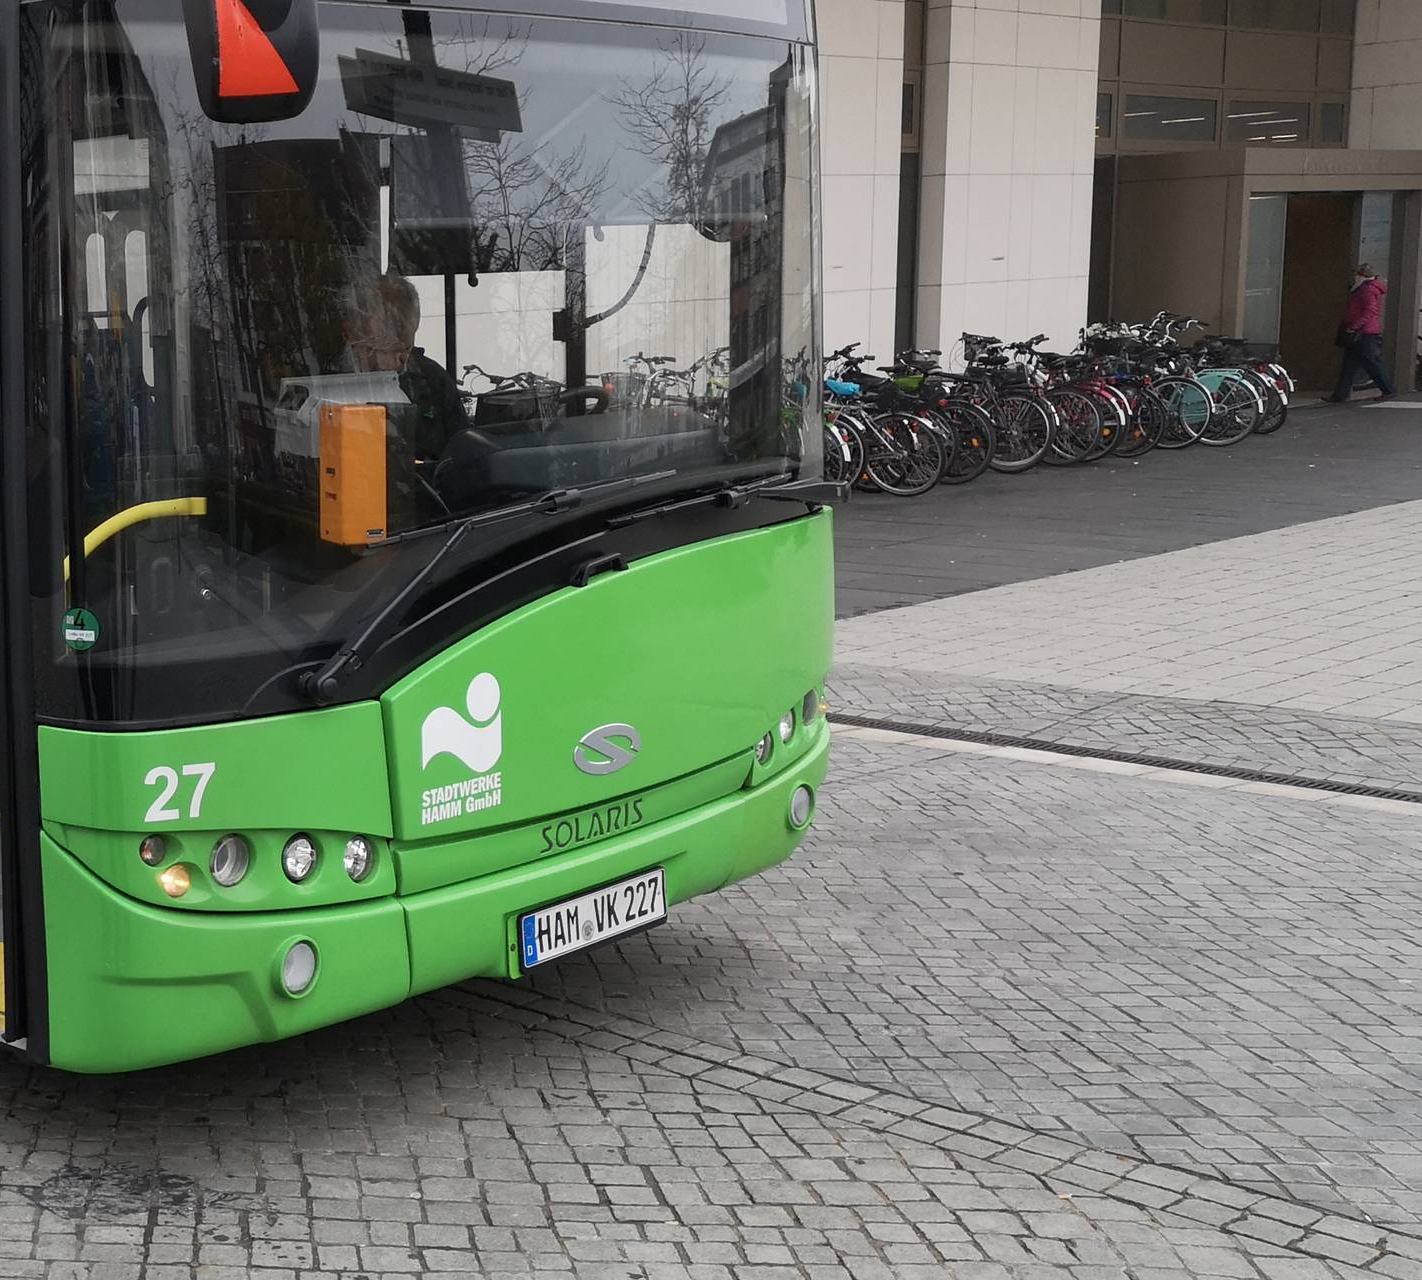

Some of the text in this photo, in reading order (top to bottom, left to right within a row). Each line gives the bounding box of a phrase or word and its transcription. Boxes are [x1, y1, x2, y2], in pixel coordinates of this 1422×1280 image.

[73, 609, 86, 630] 4
[144, 762, 216, 823] 27
[421, 772, 502, 808] STADTWERKE
[421, 789, 502, 826] HAMM GmbH
[540, 798, 643, 854] SOLARIS
[528, 876, 659, 957] D HAM VK 227
